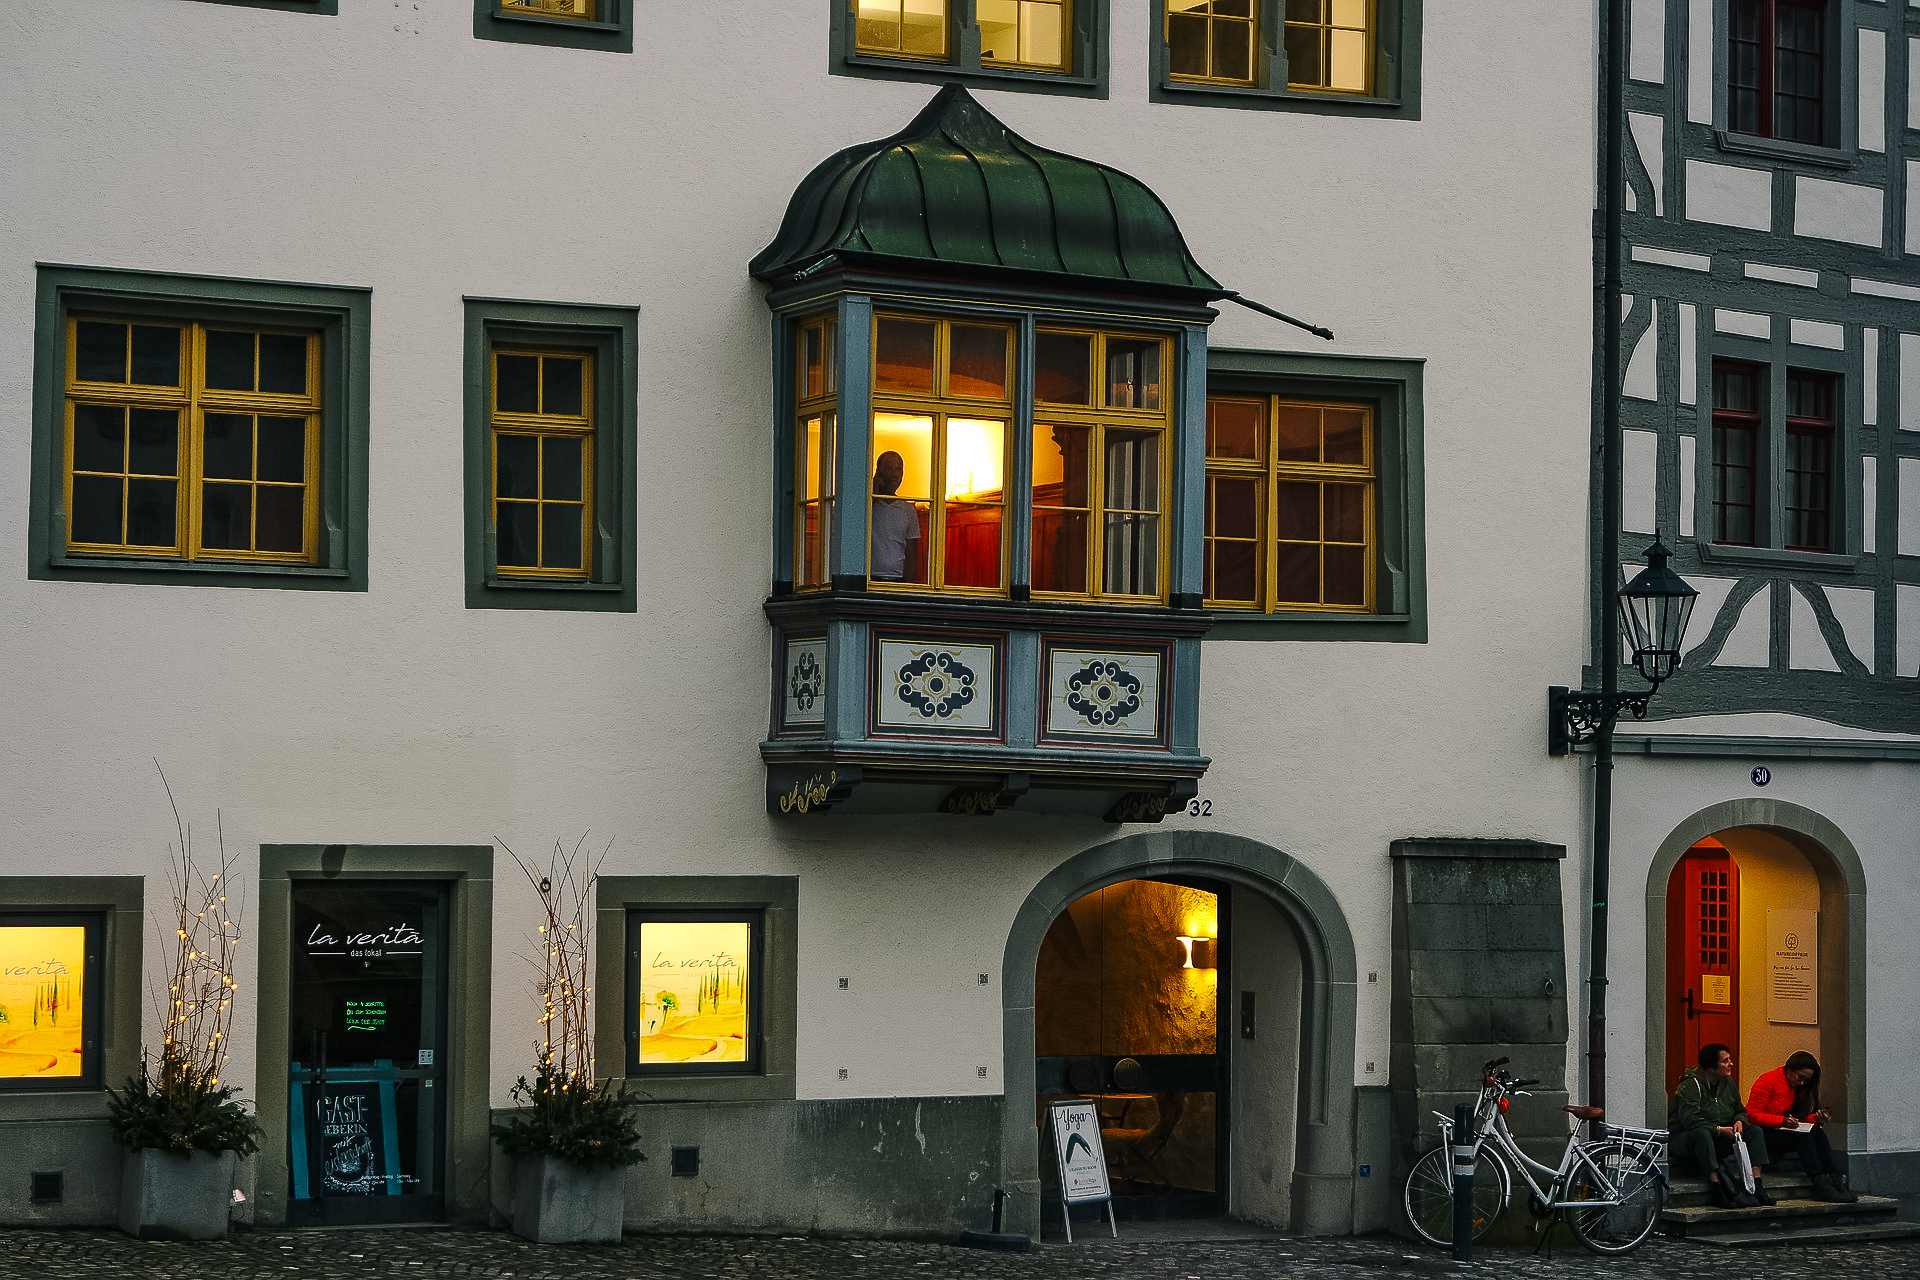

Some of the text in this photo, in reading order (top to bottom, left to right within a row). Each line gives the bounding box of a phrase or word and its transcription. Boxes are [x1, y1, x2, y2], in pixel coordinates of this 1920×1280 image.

[1755, 768, 1768, 783] 30
[1189, 800, 1213, 817] 32
[307, 923, 339, 945] la
[350, 948, 383, 957] das lokal
[652, 951, 675, 969] la
[1057, 1108, 1092, 1131] Yoga
[323, 1123, 368, 1136] EBERIN
